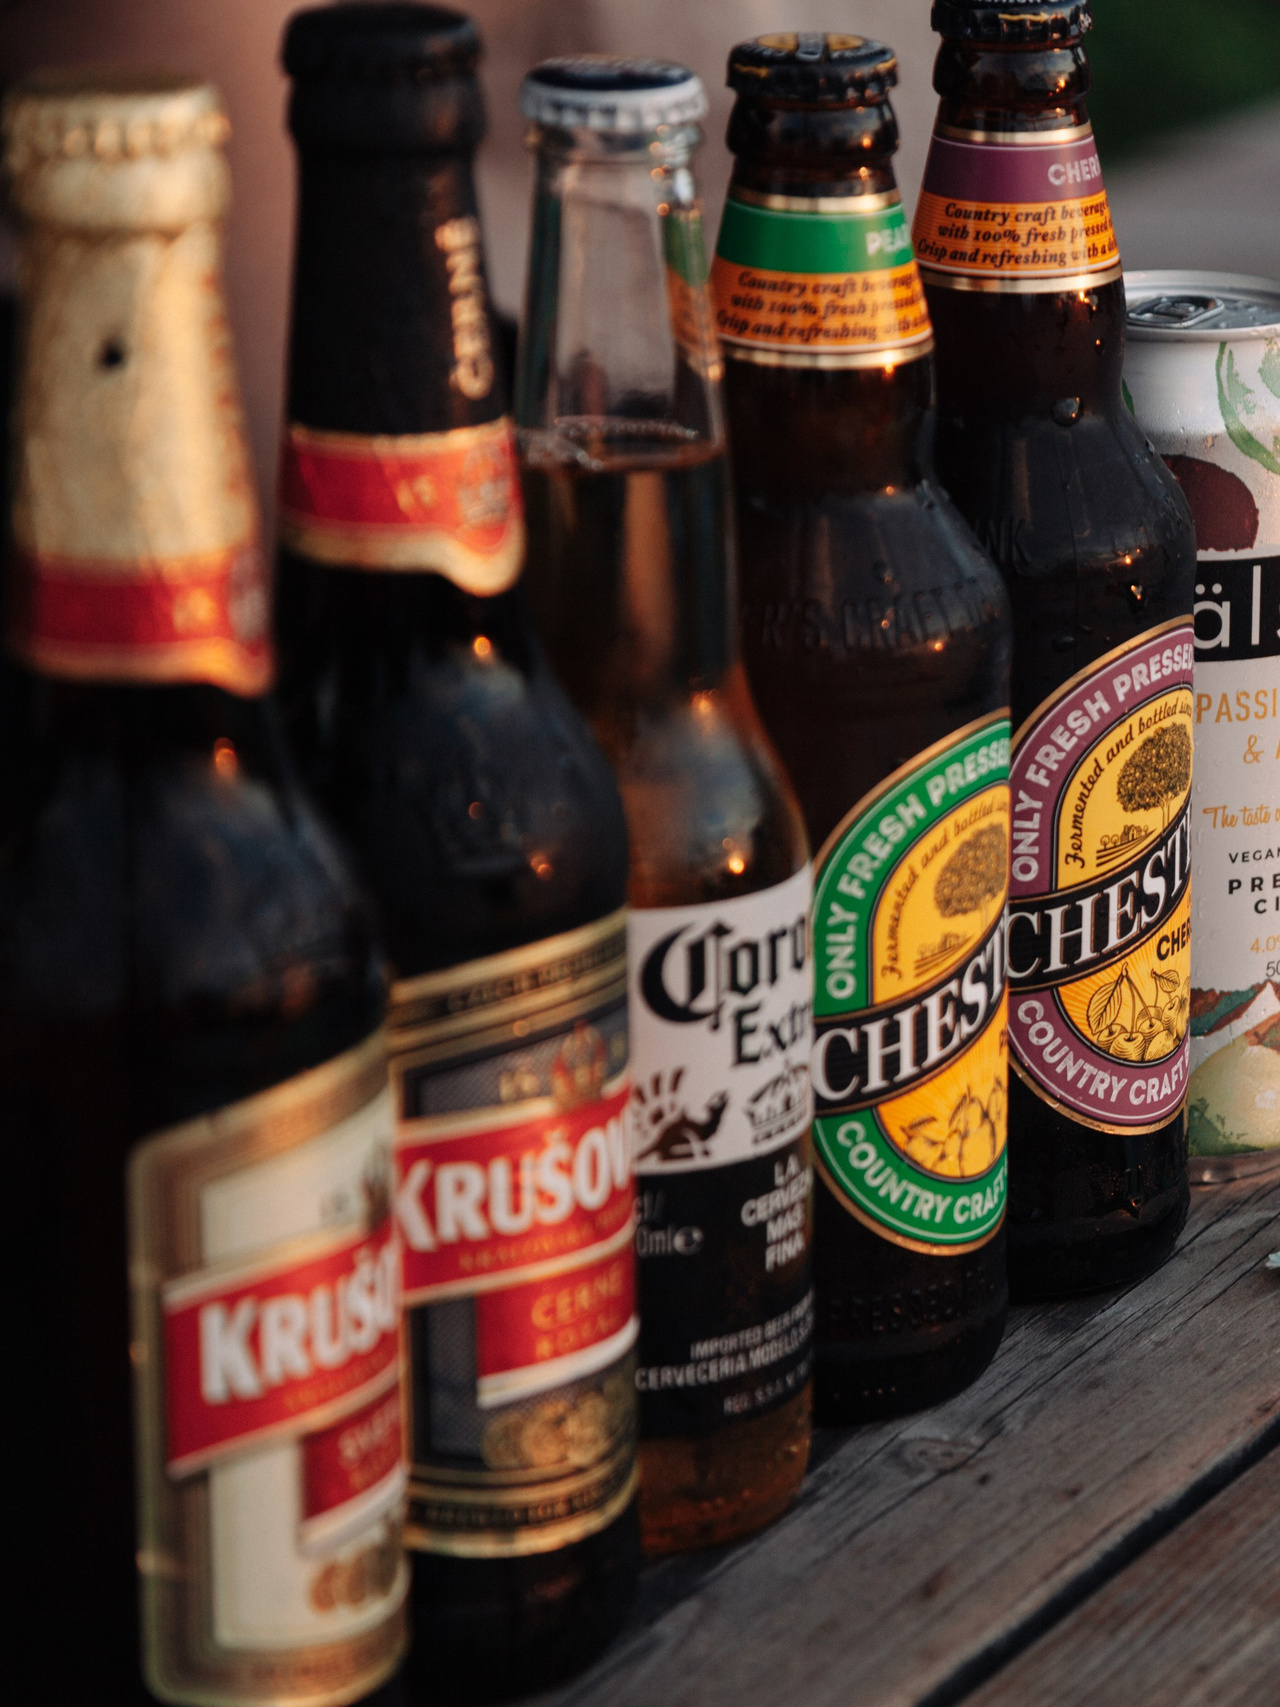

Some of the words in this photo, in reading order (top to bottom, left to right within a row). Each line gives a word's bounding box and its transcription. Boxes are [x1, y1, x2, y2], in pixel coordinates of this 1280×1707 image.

[938, 223, 969, 241] with
[974, 229, 1020, 242] 100%
[1022, 225, 1066, 247] fresh
[1070, 216, 1108, 244] pressed
[945, 203, 1010, 225] Country
[1014, 205, 1056, 226] craft
[918, 239, 947, 262] Crisp
[950, 249, 980, 262] and
[982, 249, 1067, 268] refreshing
[1071, 243, 1098, 260] with
[739, 271, 806, 298] Country
[812, 277, 857, 297] craft
[731, 294, 764, 311] with
[769, 301, 818, 315] 100%
[822, 299, 866, 319] fresh
[717, 310, 748, 332] Crisp
[753, 321, 785, 337] and
[788, 321, 877, 341] refreshing
[1112, 643, 1193, 702] PRESSED
[1025, 690, 1111, 787] FRESH
[1243, 734, 1264, 764] &
[1064, 760, 1105, 869] Fermented
[1106, 729, 1134, 765] and
[1138, 698, 1178, 734] bottled
[1011, 789, 1043, 882] ONLY
[1202, 806, 1238, 829] The
[1243, 806, 1270, 826] taste
[837, 793, 927, 900] FRESH
[921, 829, 949, 866] and
[826, 901, 860, 999] ONLY
[1017, 1000, 1128, 1103] COUNTRY
[1129, 1059, 1184, 1105] CRAFT
[774, 1153, 800, 1186] LA
[836, 1121, 954, 1224] COUNTRY
[953, 1173, 1006, 1224] CRAFT
[765, 1231, 805, 1272] FINA
[690, 1325, 763, 1360] IMPORTED
[635, 1353, 747, 1391] CERVECERIA
